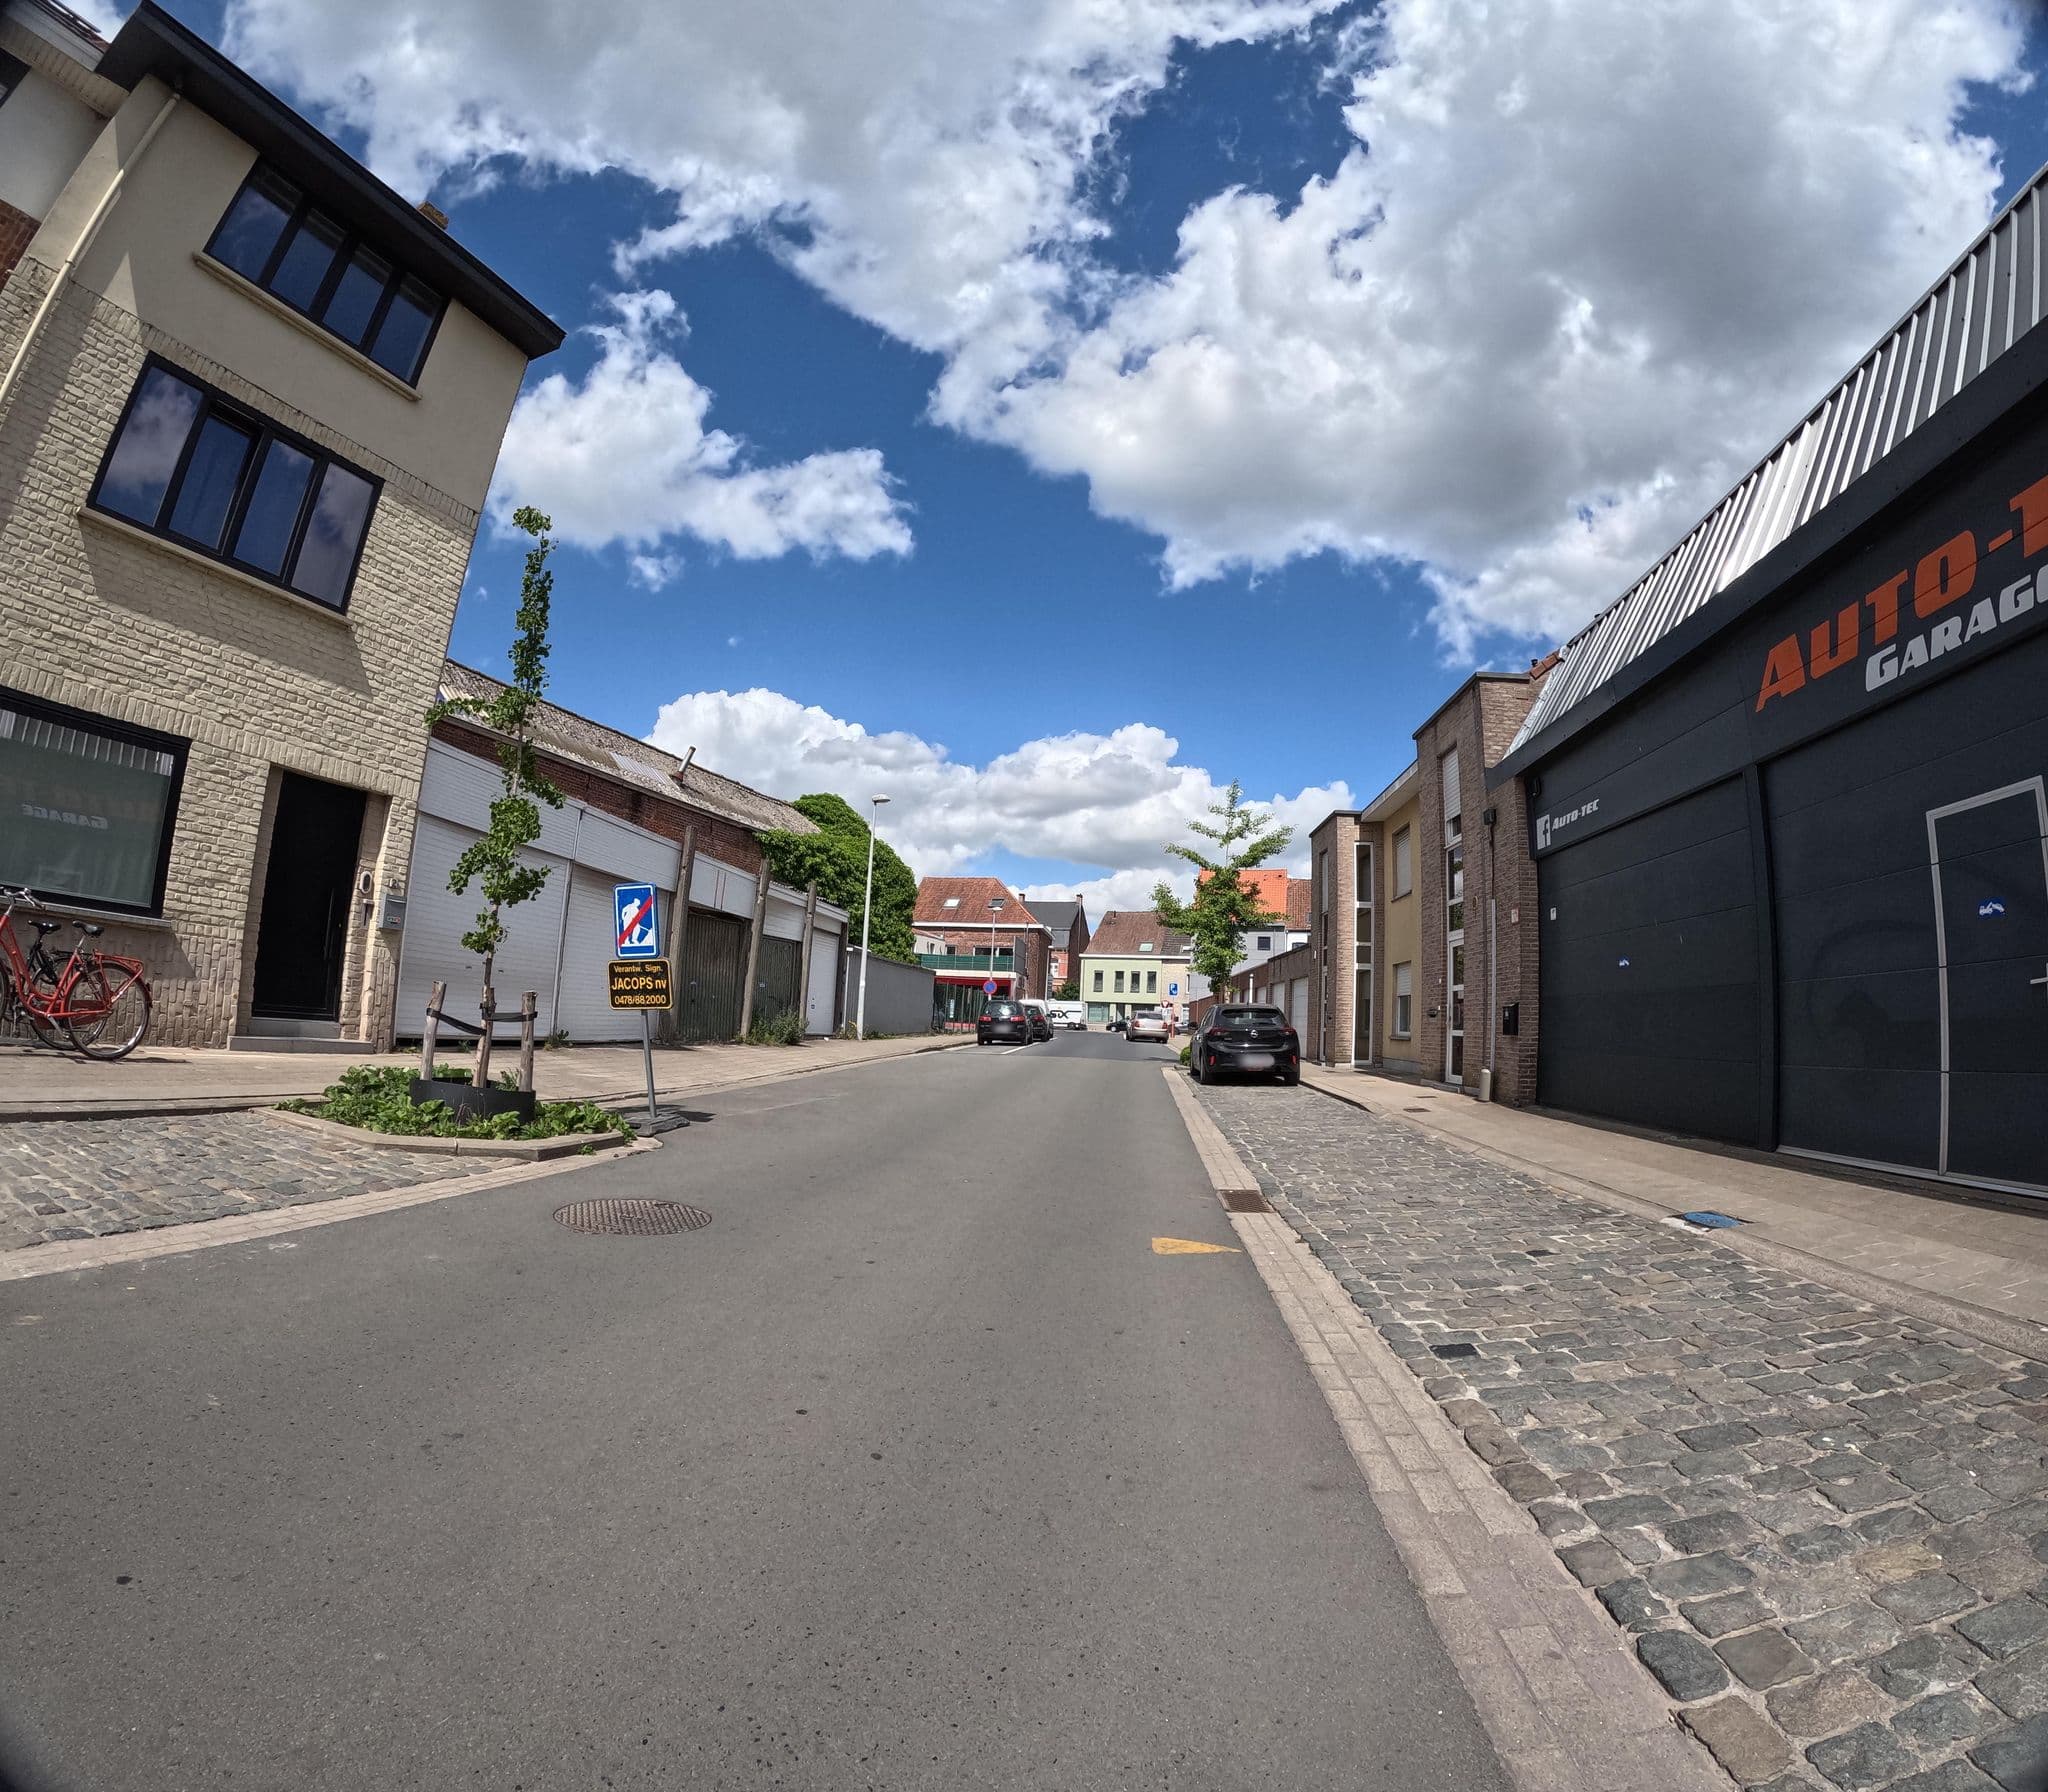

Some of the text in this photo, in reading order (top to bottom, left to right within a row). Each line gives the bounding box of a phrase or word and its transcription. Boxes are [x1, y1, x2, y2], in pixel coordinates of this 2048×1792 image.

[1552, 799, 1600, 831] AUTO-TEC
[611, 976, 667, 990] JACOPS nv
